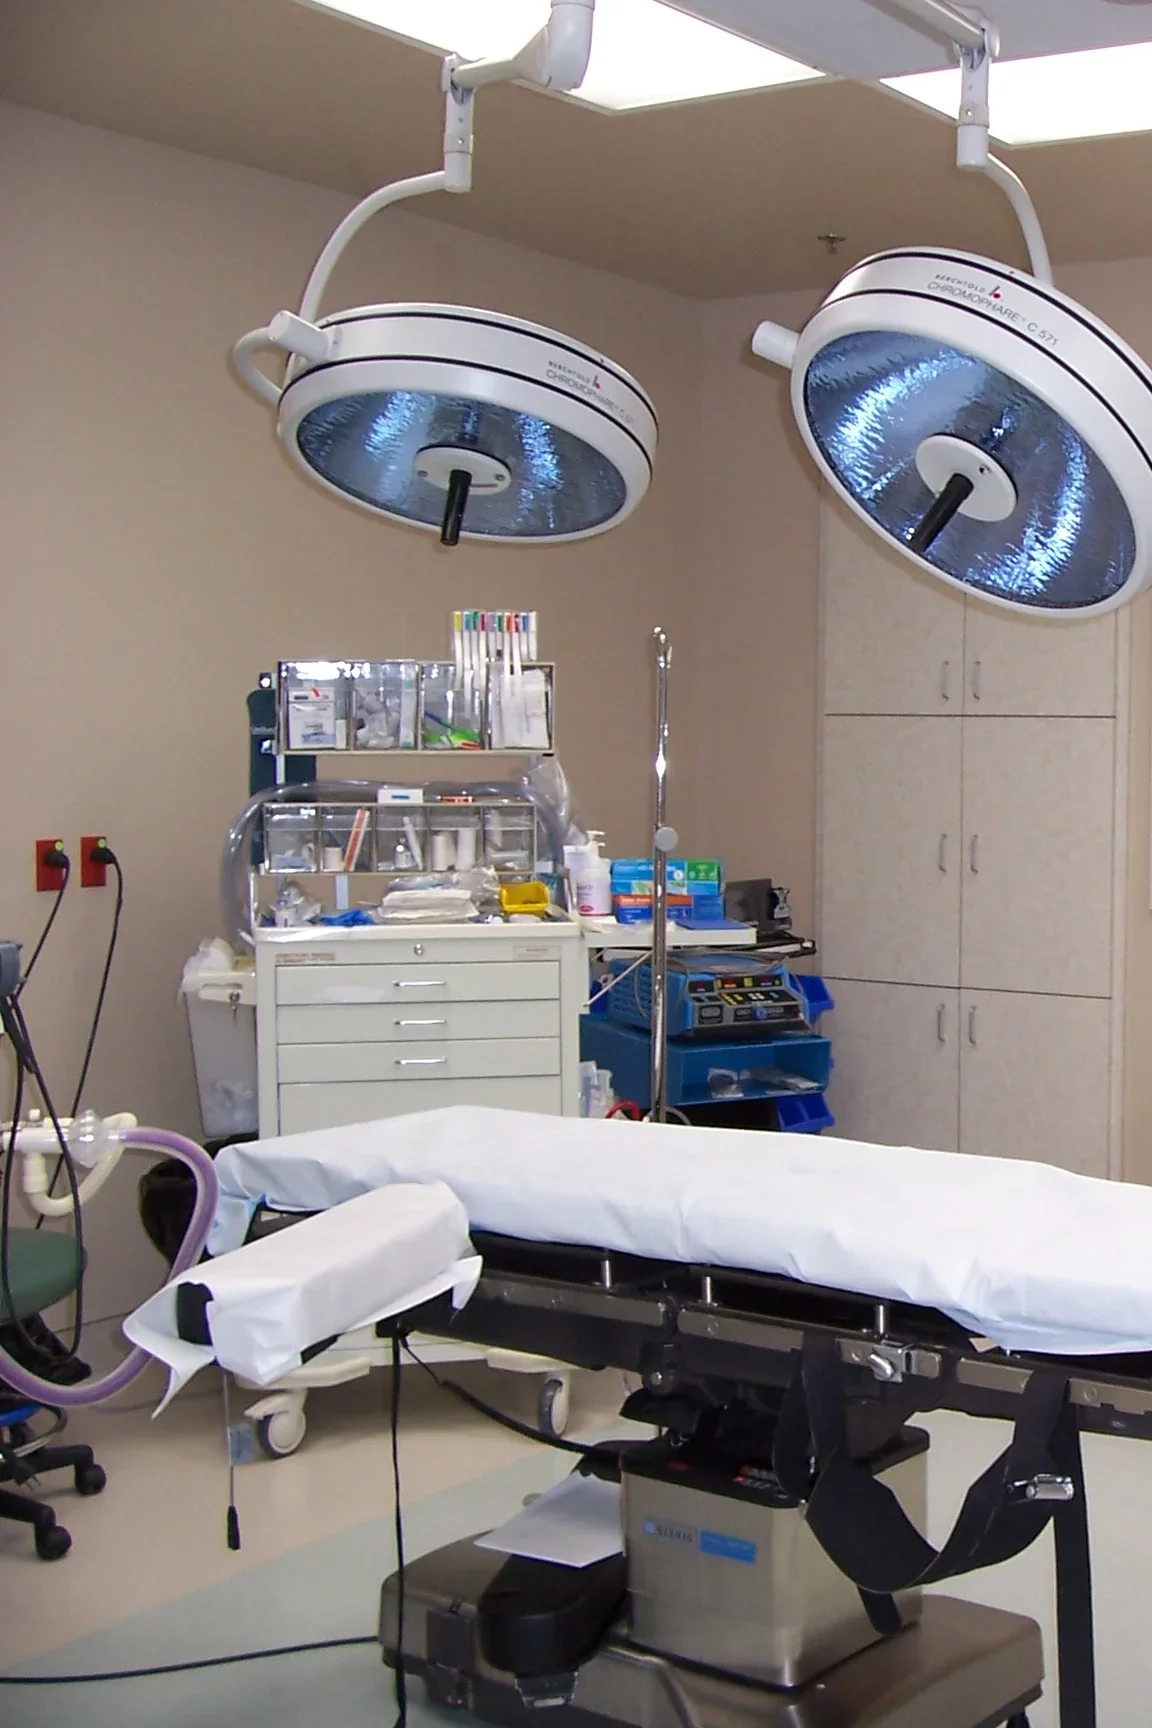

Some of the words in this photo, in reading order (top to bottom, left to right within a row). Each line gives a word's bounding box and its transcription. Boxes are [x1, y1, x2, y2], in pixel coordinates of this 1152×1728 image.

[927, 281, 1021, 322] CHROMOPHARE
[1026, 322, 1039, 333] C
[1038, 328, 1059, 346] 571
